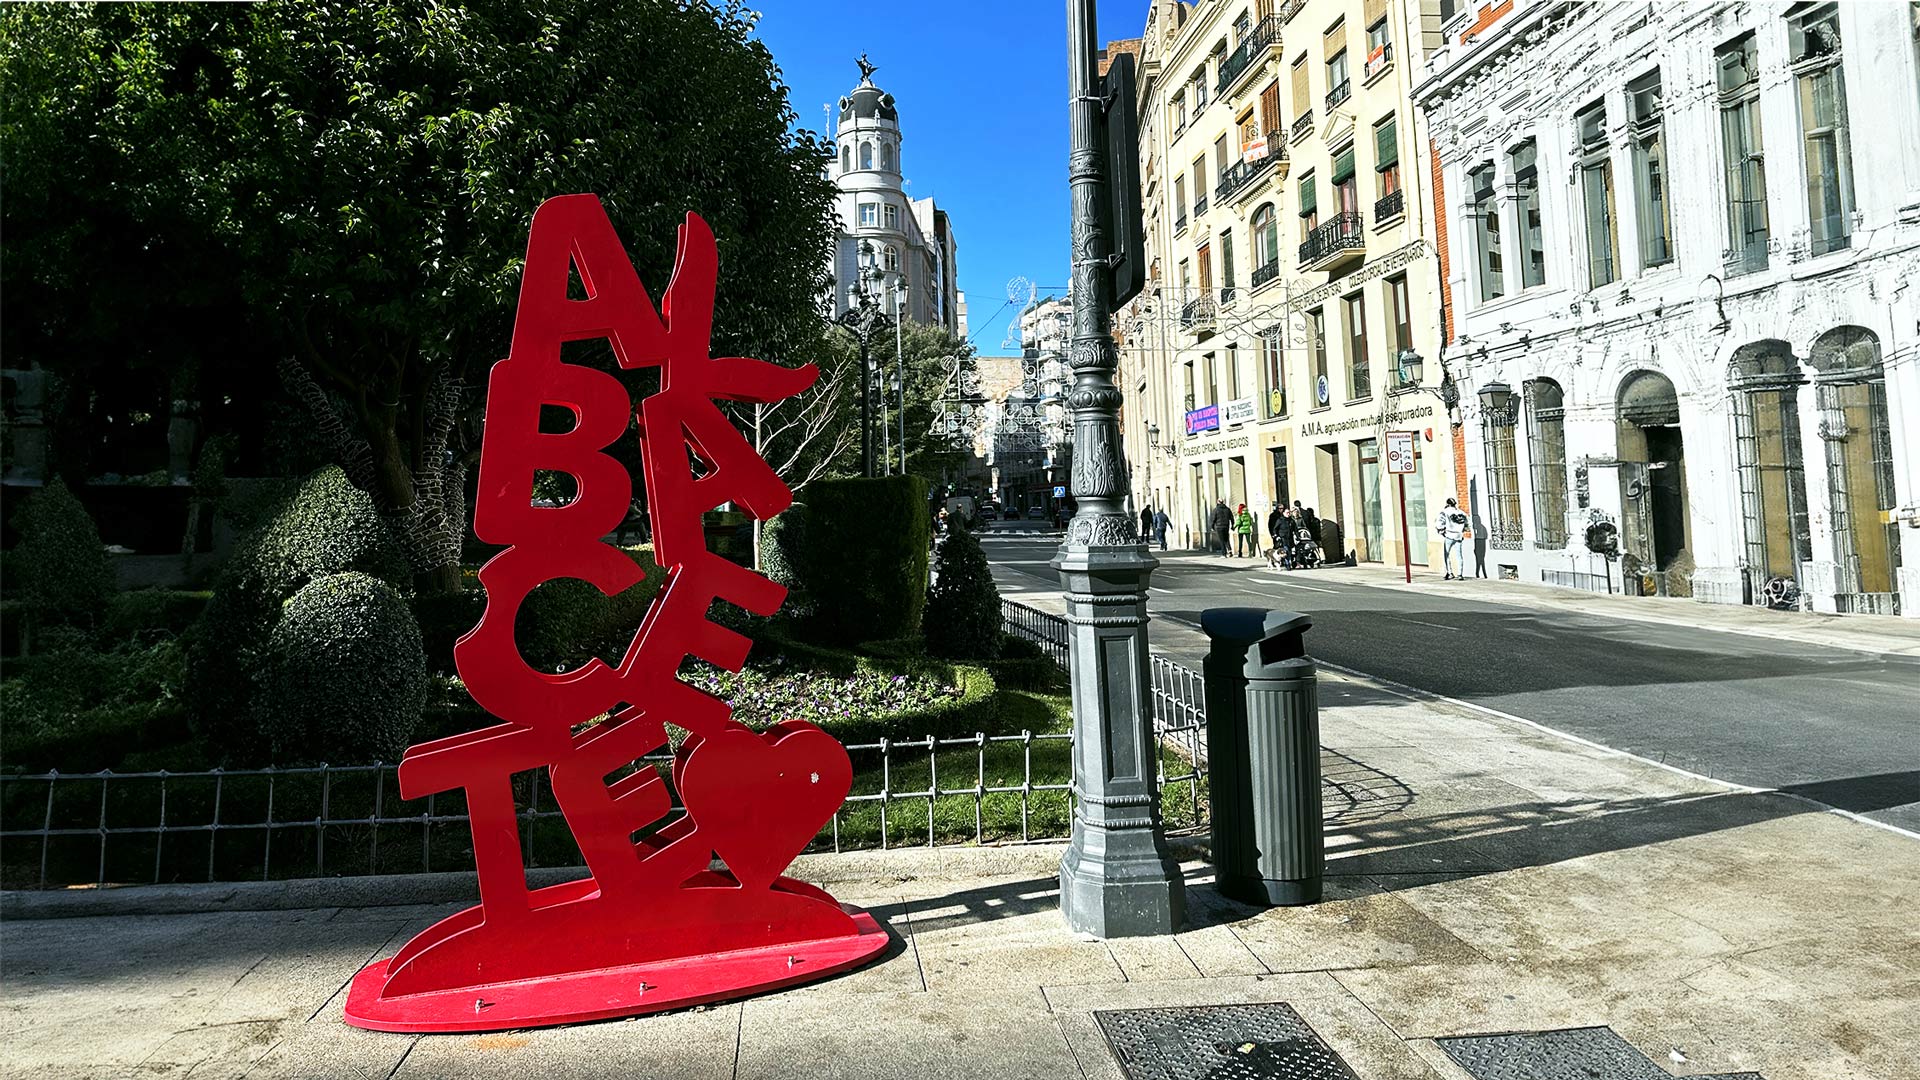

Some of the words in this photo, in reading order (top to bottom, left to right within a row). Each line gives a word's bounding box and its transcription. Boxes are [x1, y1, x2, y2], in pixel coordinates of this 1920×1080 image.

[1324, 417, 1359, 436] agrupación
[1360, 413, 1384, 427] mutual
[1385, 405, 1433, 424] aseguradora
[1183, 445, 1201, 457] COLEGIO
[1201, 441, 1218, 454] OFICIAL
[1218, 440, 1226, 451] DE
